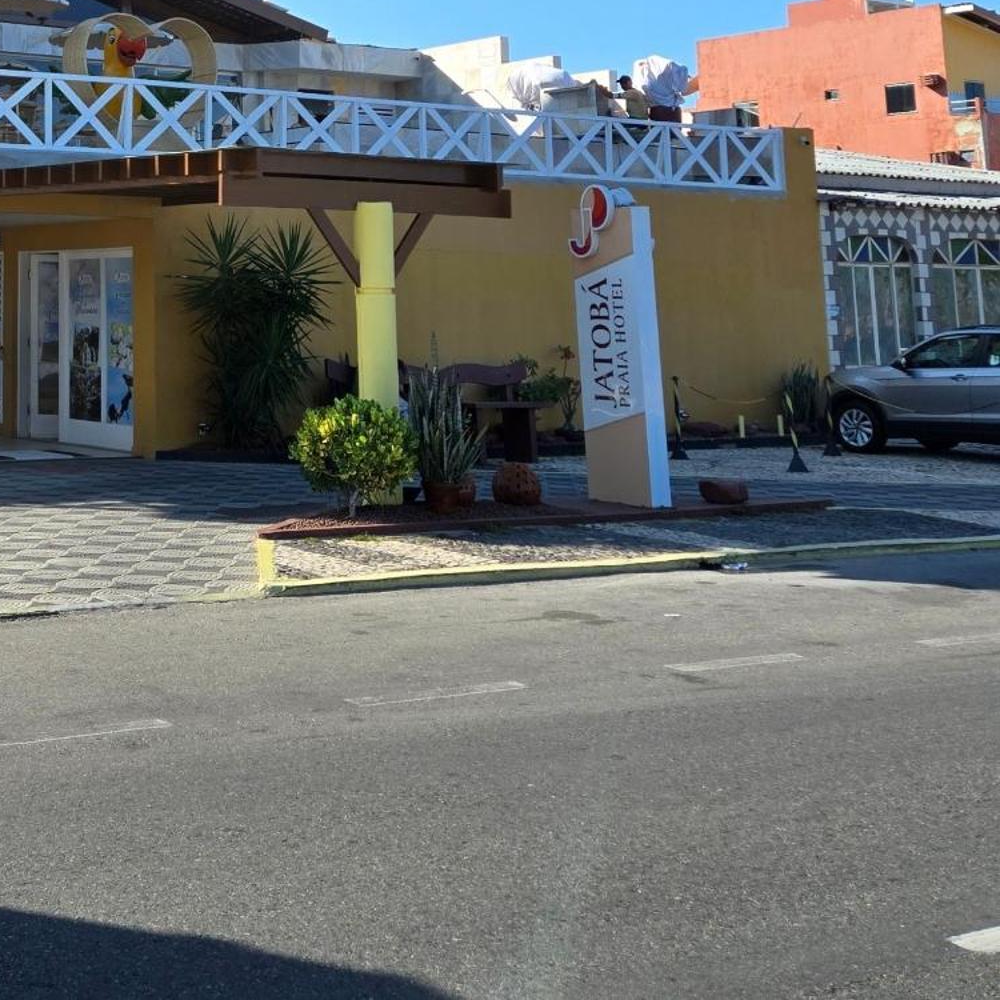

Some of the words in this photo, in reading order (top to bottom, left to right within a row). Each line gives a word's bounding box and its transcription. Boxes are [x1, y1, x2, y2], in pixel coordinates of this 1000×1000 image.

[580, 277, 617, 409] JATOBÁ
[611, 278, 626, 343] HOTEL
[615, 350, 631, 408] PRAIA
